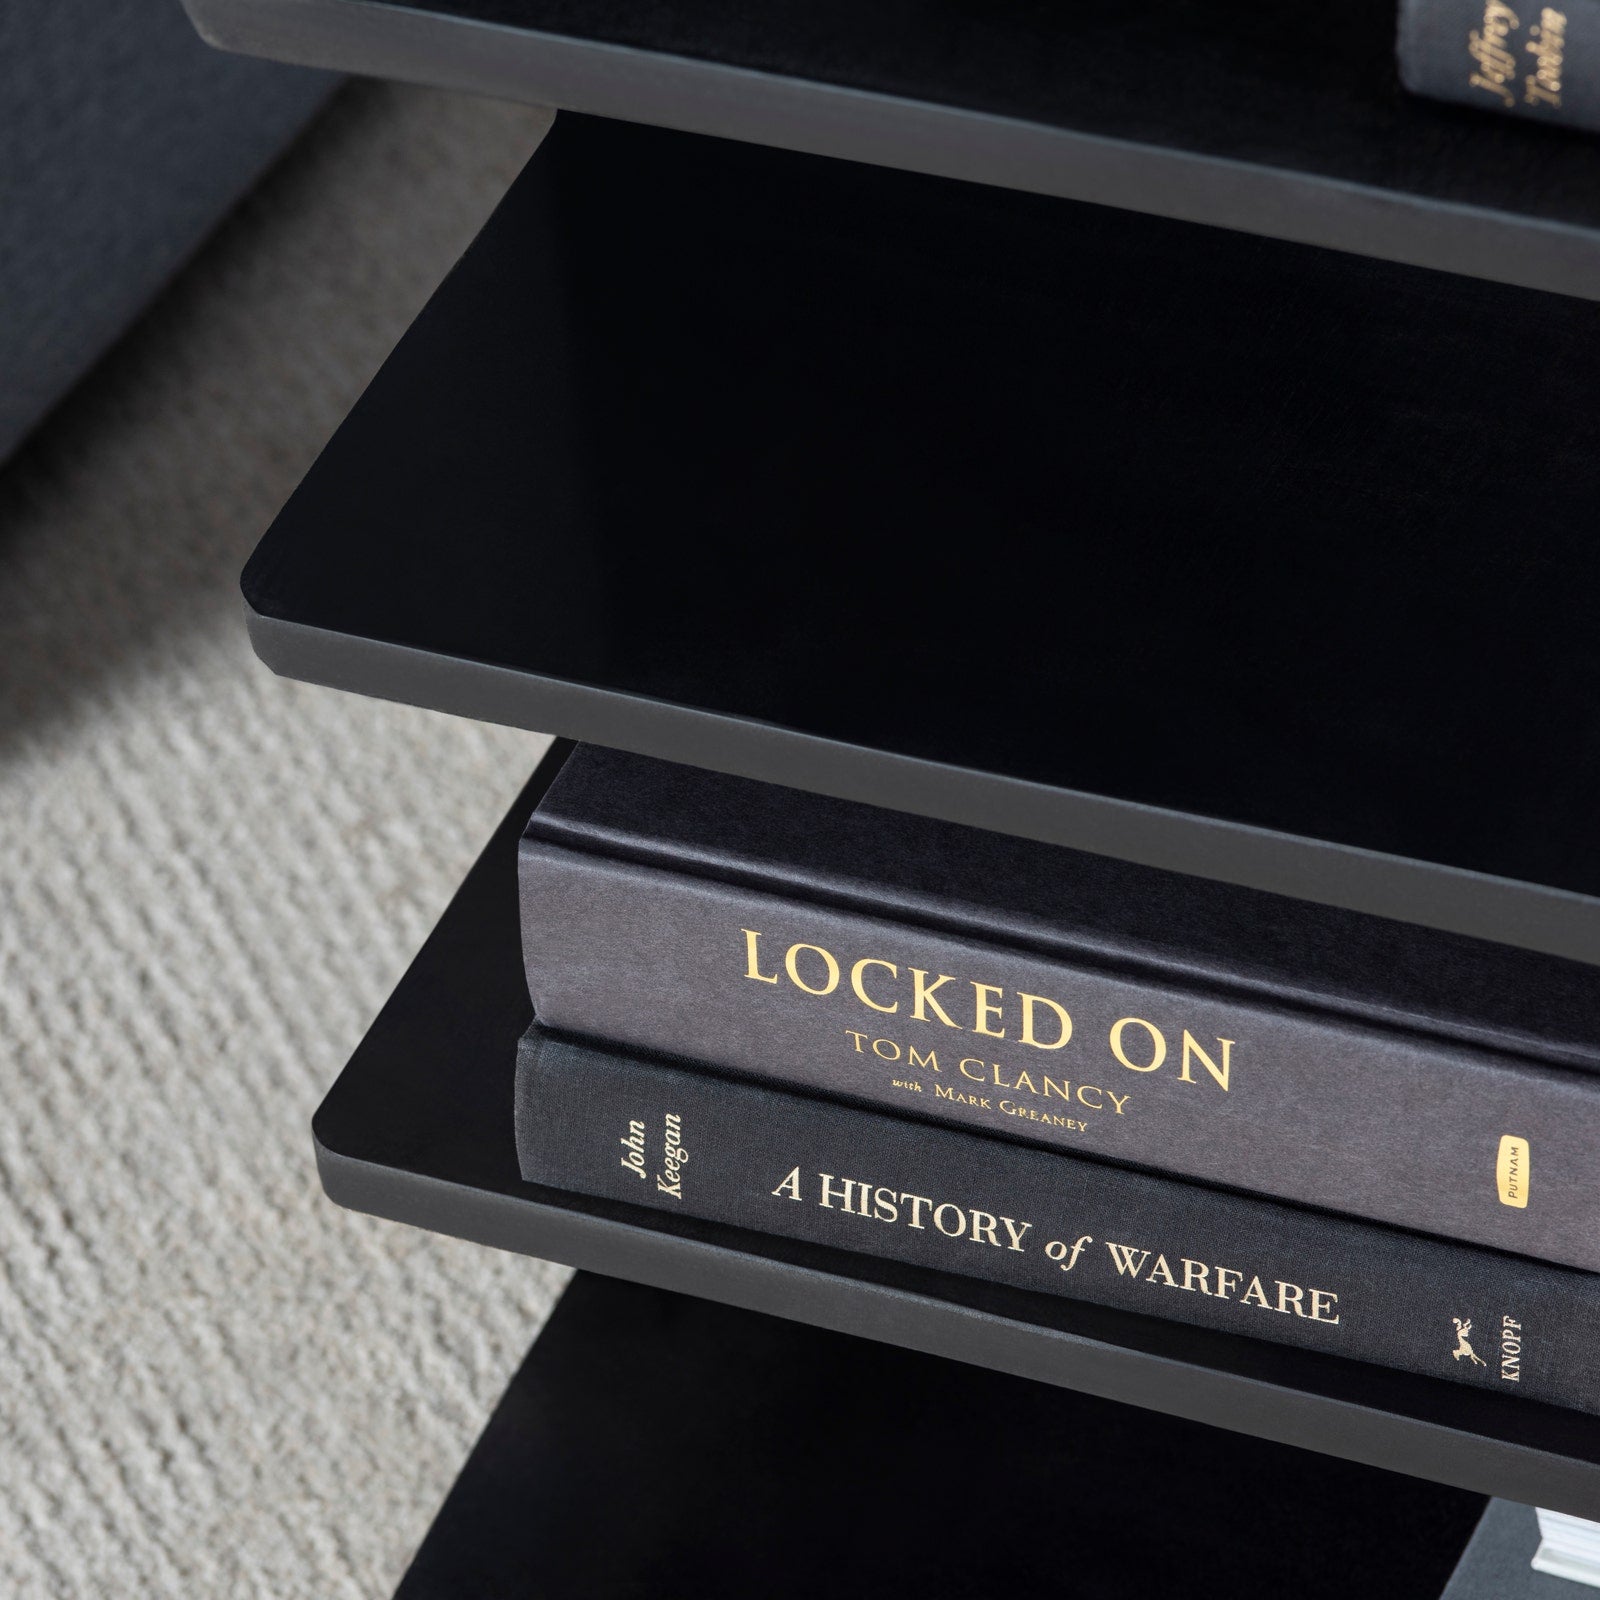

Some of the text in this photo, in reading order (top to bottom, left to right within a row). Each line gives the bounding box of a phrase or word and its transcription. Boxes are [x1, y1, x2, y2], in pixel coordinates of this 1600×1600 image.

[741, 929, 1235, 1092] LOCKED ON
[846, 1030, 1131, 1115] TOM CLANCY
[892, 1078, 923, 1093] with
[620, 1120, 646, 1179] John
[657, 1113, 689, 1200] Keegan
[1508, 1146, 1519, 1199] PUTNAM
[771, 1166, 1340, 1325] A HISTORY of WARFARE
[1501, 1315, 1522, 1383] KNOPF
